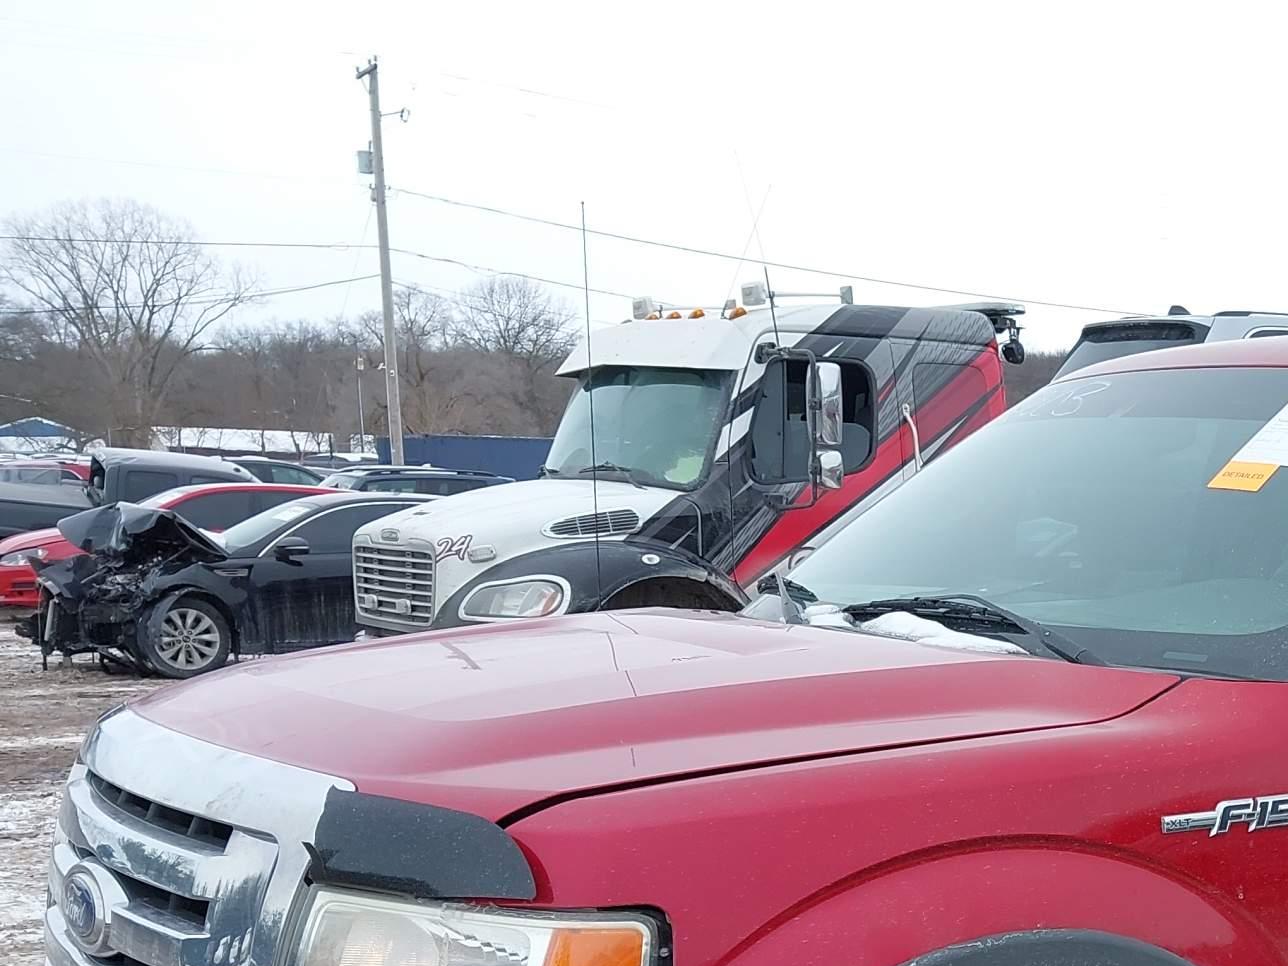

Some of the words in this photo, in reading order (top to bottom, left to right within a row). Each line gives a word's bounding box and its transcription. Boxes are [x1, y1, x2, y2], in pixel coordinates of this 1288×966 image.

[1222, 470, 1265, 480] DETAILED
[435, 535, 473, 563] 24
[1169, 818, 1192, 831] XLT
